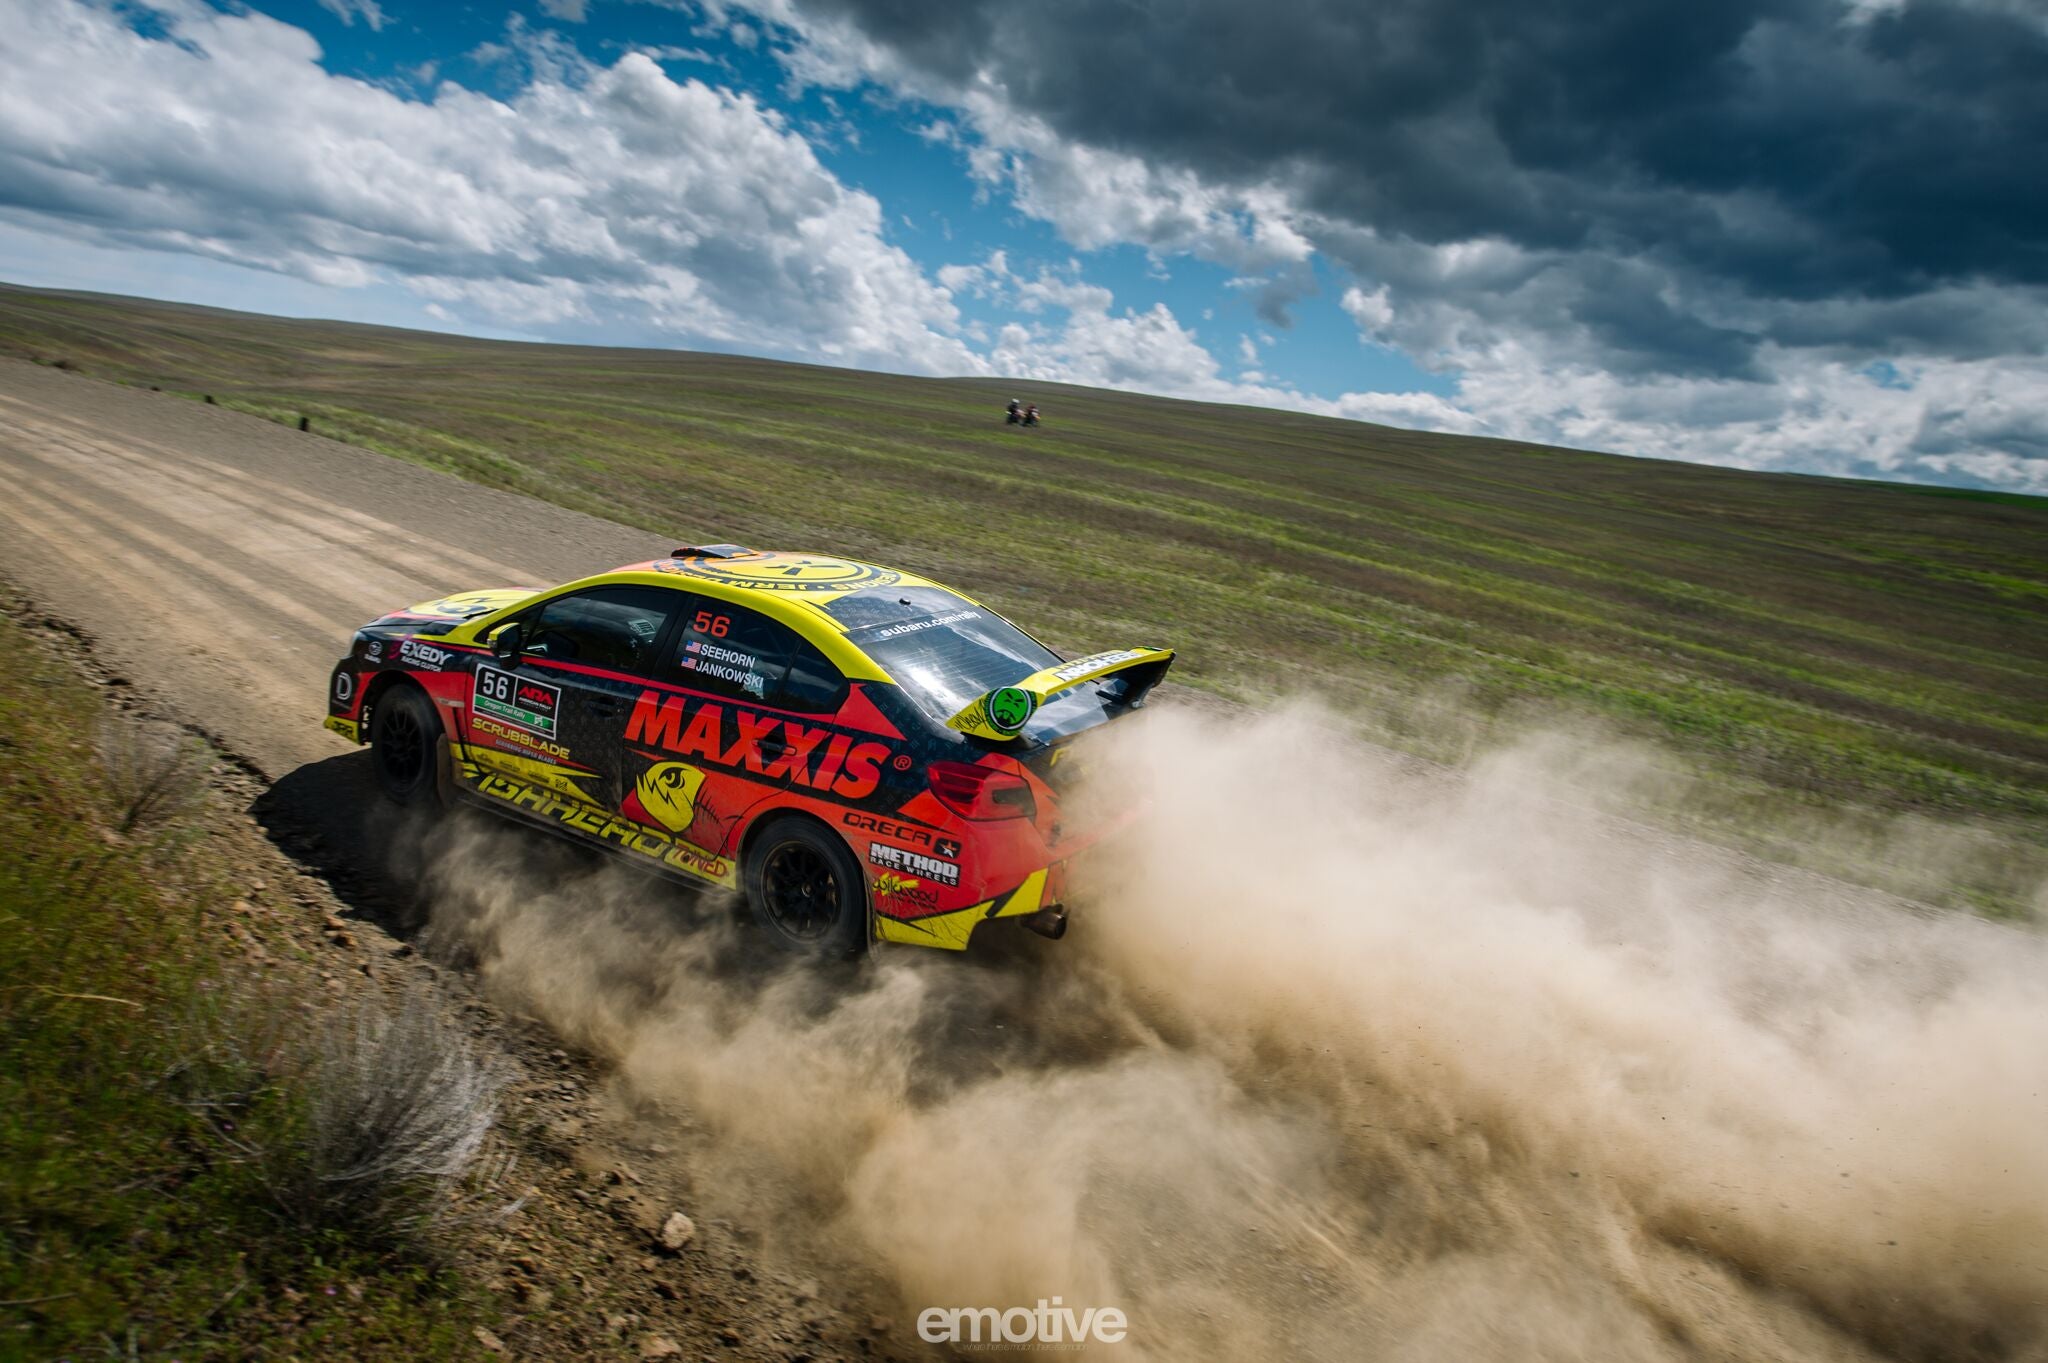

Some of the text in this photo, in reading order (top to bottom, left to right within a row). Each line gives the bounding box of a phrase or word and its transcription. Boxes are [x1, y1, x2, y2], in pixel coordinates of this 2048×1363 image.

[693, 611, 731, 638] 56
[880, 611, 982, 637] subaru.com/rally
[400, 641, 454, 666] EXEDY
[700, 644, 756, 669] SEEHORN
[483, 671, 508, 700] 56
[696, 661, 764, 689] JANKOWSKI
[484, 700, 502, 710] Oregon
[513, 710, 526, 719] Rally
[472, 717, 571, 760] SCRUBBLADE
[624, 689, 892, 799] MAXXIS
[843, 811, 932, 846] ORECA
[870, 842, 959, 879] METHOD
[870, 856, 958, 886] RACE WHEELS
